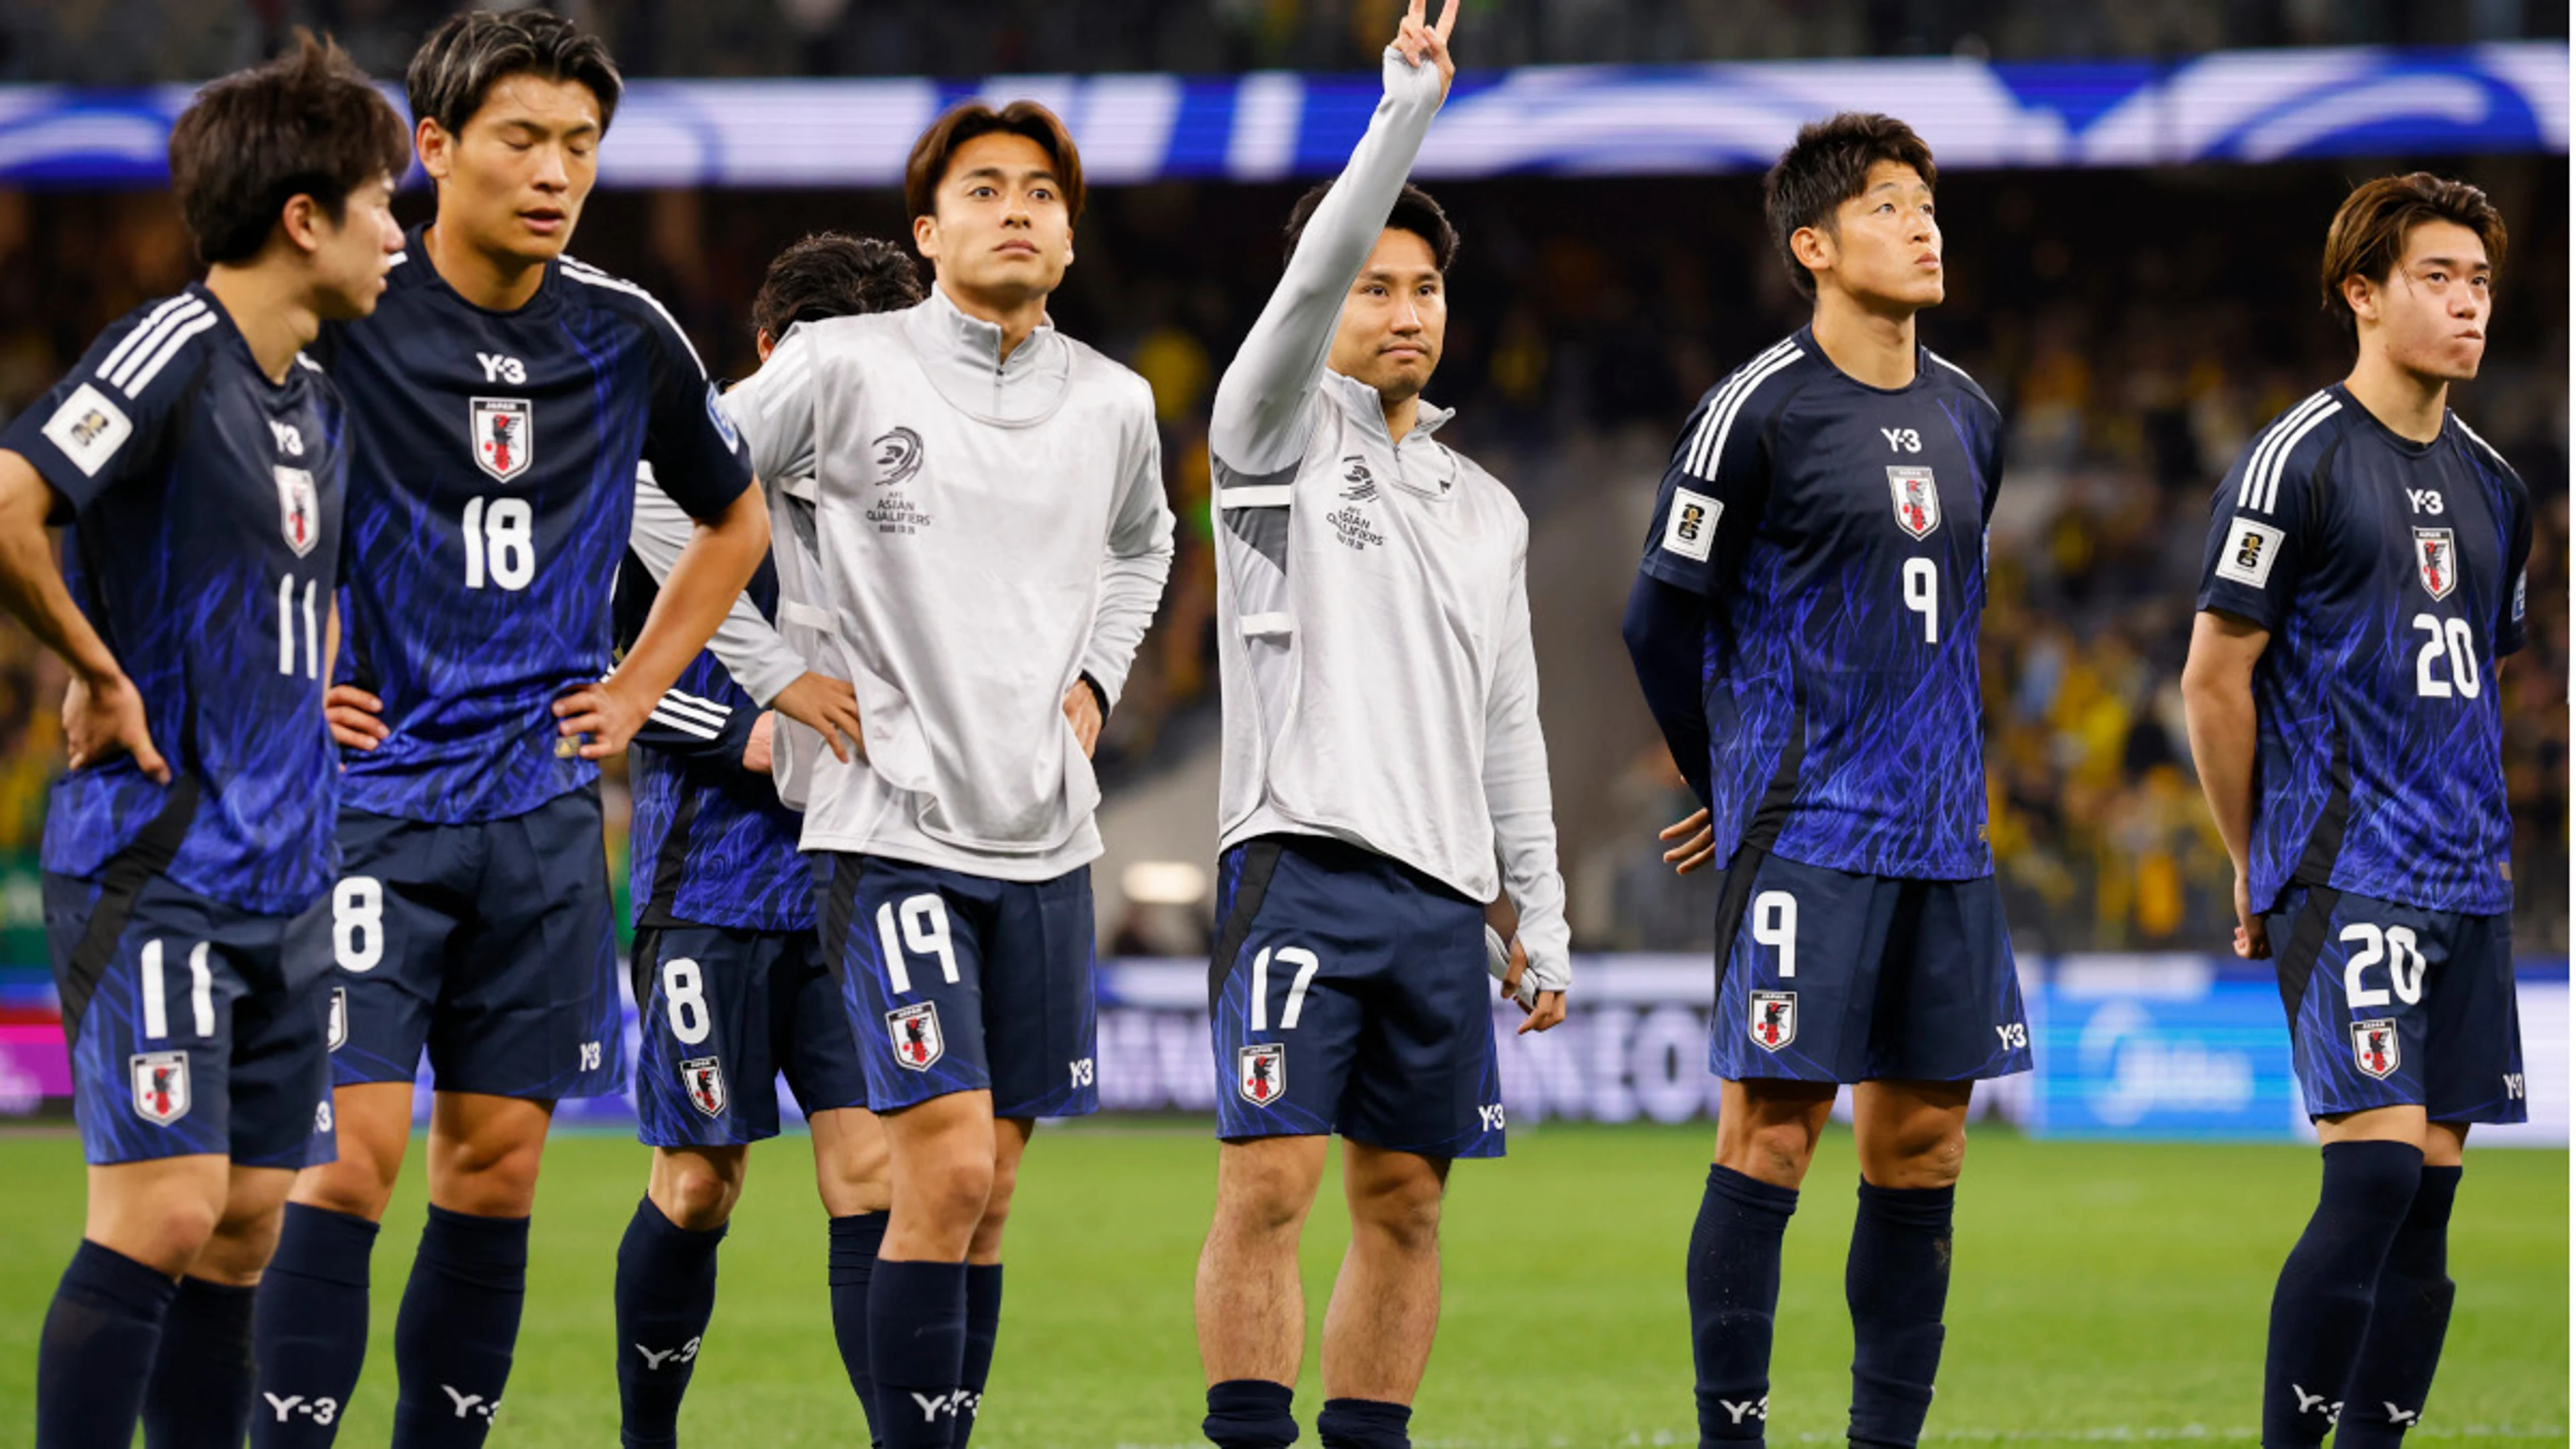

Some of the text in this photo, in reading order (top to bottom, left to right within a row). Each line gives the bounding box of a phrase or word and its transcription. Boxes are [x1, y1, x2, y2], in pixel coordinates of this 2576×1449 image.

[476, 352, 527, 385] Y-3
[268, 420, 304, 456] Y-3
[1880, 427, 1923, 454] Y-3
[865, 509, 931, 527] QUALIFIERS
[876, 498, 916, 512] ASIAN
[2406, 487, 2444, 516] Y-3
[462, 496, 535, 591] 18
[1902, 557, 1938, 644] 9
[278, 572, 319, 680] 11
[2412, 613, 2481, 700] 20
[331, 875, 384, 973] 8
[1752, 890, 1798, 977] 9
[875, 892, 961, 995] 19
[2339, 922, 2427, 1009] 20
[140, 938, 215, 1040] 11
[662, 957, 711, 1045] 8
[1250, 946, 1319, 1032] 17
[1996, 1022, 2027, 1051] Y-3
[1069, 1057, 1093, 1089] Y-3
[2503, 1073, 2524, 1100] Y-3
[313, 1100, 333, 1134] -3
[1479, 1103, 1505, 1132] Y-3
[635, 1336, 701, 1370] Y-3
[264, 1392, 337, 1425] Y-3
[1720, 1395, 1769, 1424] Y-3
[2383, 1401, 2422, 1426] Y-
